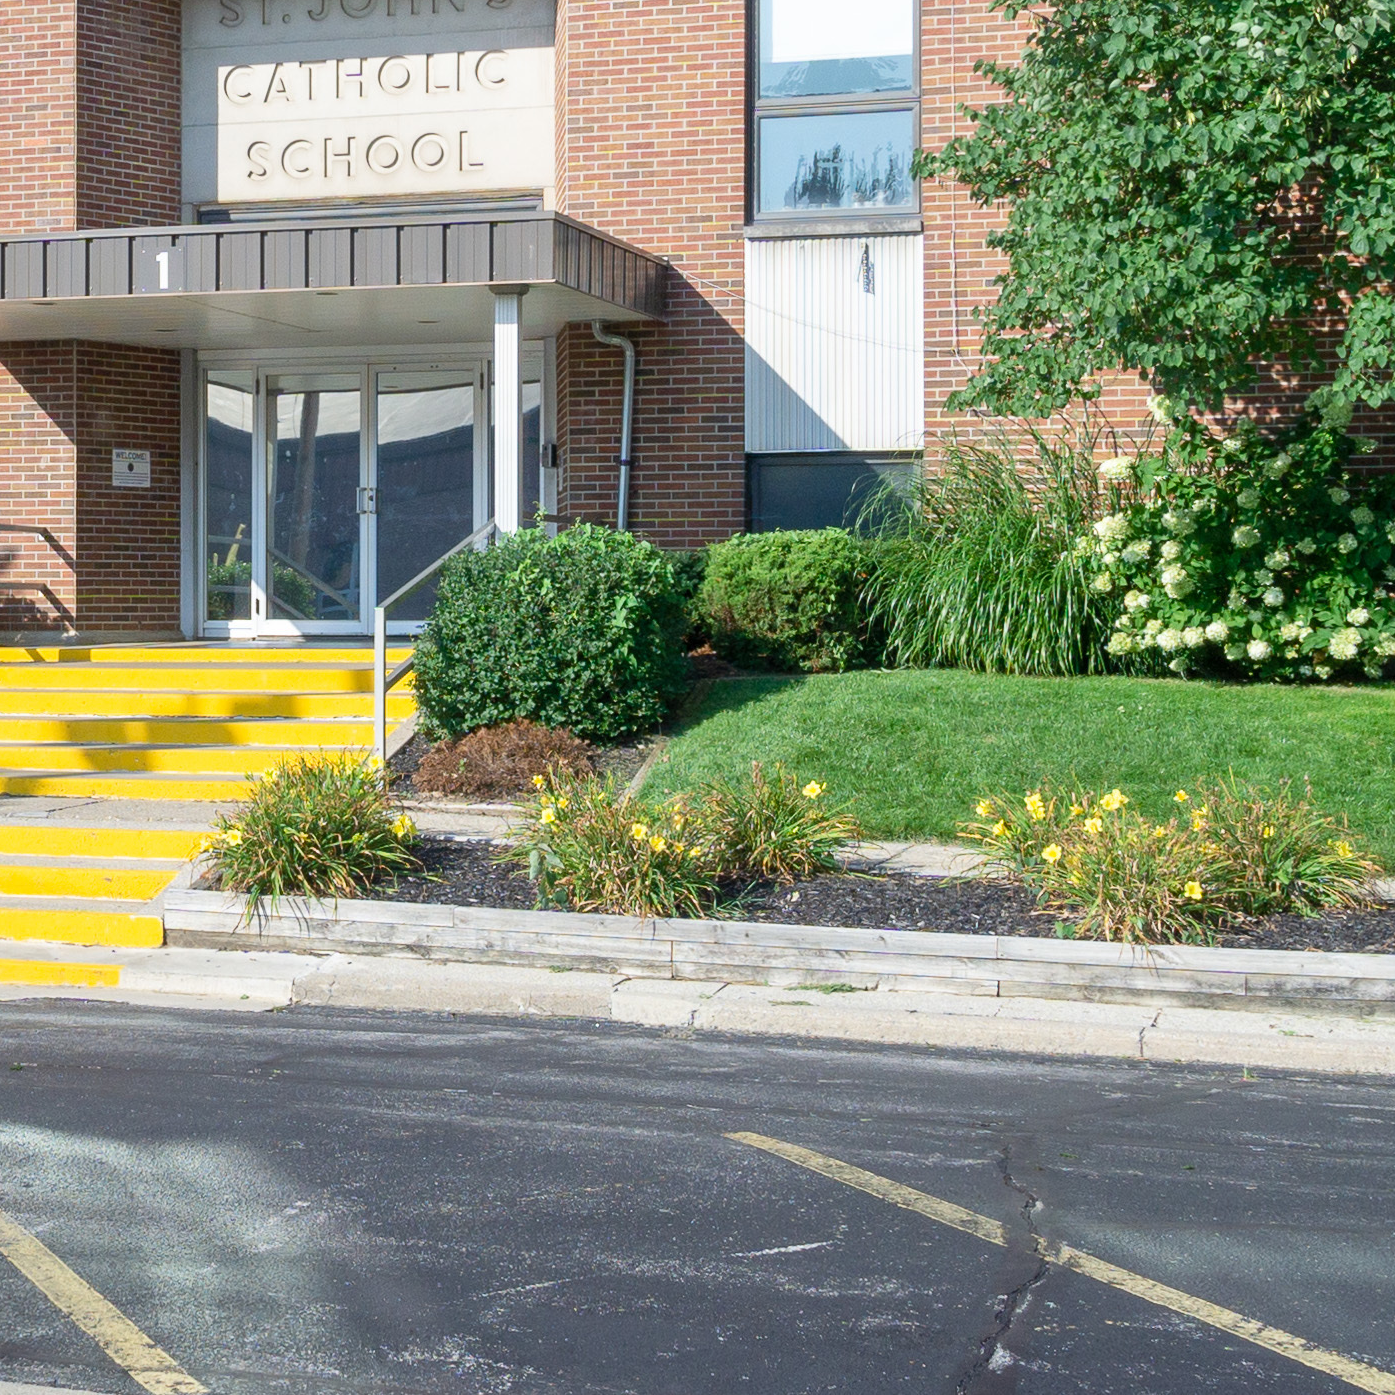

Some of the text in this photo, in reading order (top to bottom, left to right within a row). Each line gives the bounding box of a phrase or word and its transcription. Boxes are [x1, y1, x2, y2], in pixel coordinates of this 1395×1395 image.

[222, 49, 509, 105] CATHOLIC
[246, 130, 485, 181] SCHOOL
[155, 251, 169, 290] 1
